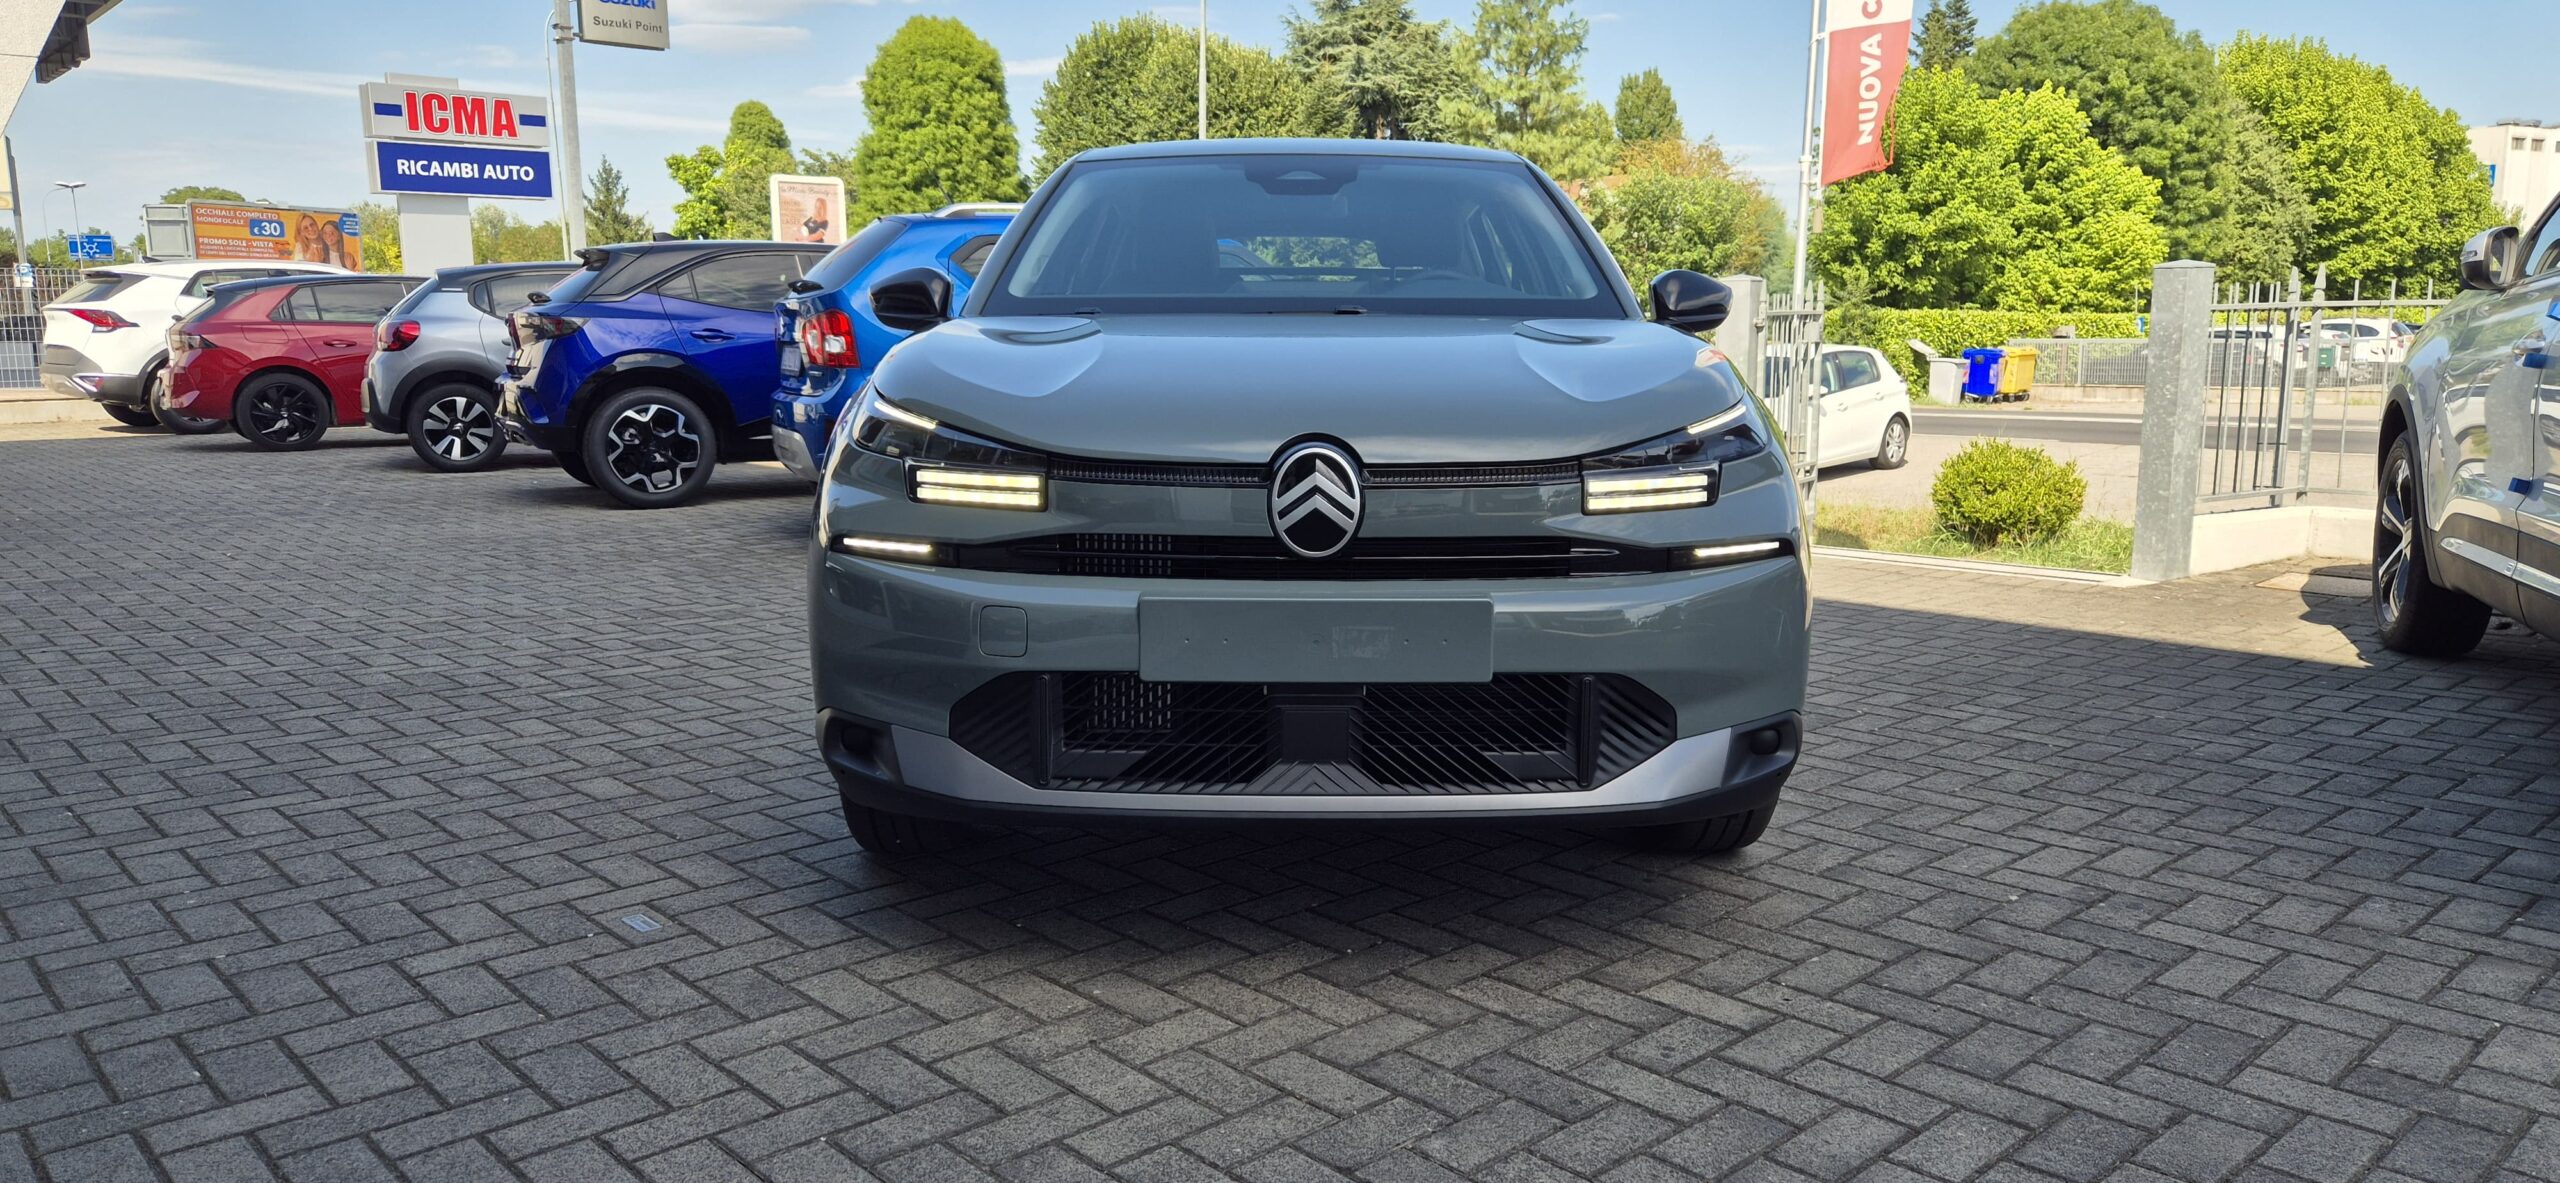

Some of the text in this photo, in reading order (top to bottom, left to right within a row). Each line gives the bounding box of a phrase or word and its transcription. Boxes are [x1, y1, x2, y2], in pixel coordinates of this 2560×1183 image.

[593, 16, 663, 33] Suzuki Point
[1857, 33, 1882, 145] NUOVA
[404, 91, 520, 138] ICMA
[397, 159, 534, 181] RICAMBI AUTO
[195, 207, 278, 220] OCCHIALE COMPLETO
[196, 216, 244, 225] MONOFOCALE
[253, 222, 280, 236] € 30
[199, 237, 227, 246] PROMO
[229, 239, 246, 247] SOLE
[252, 240, 274, 248] VISTA
